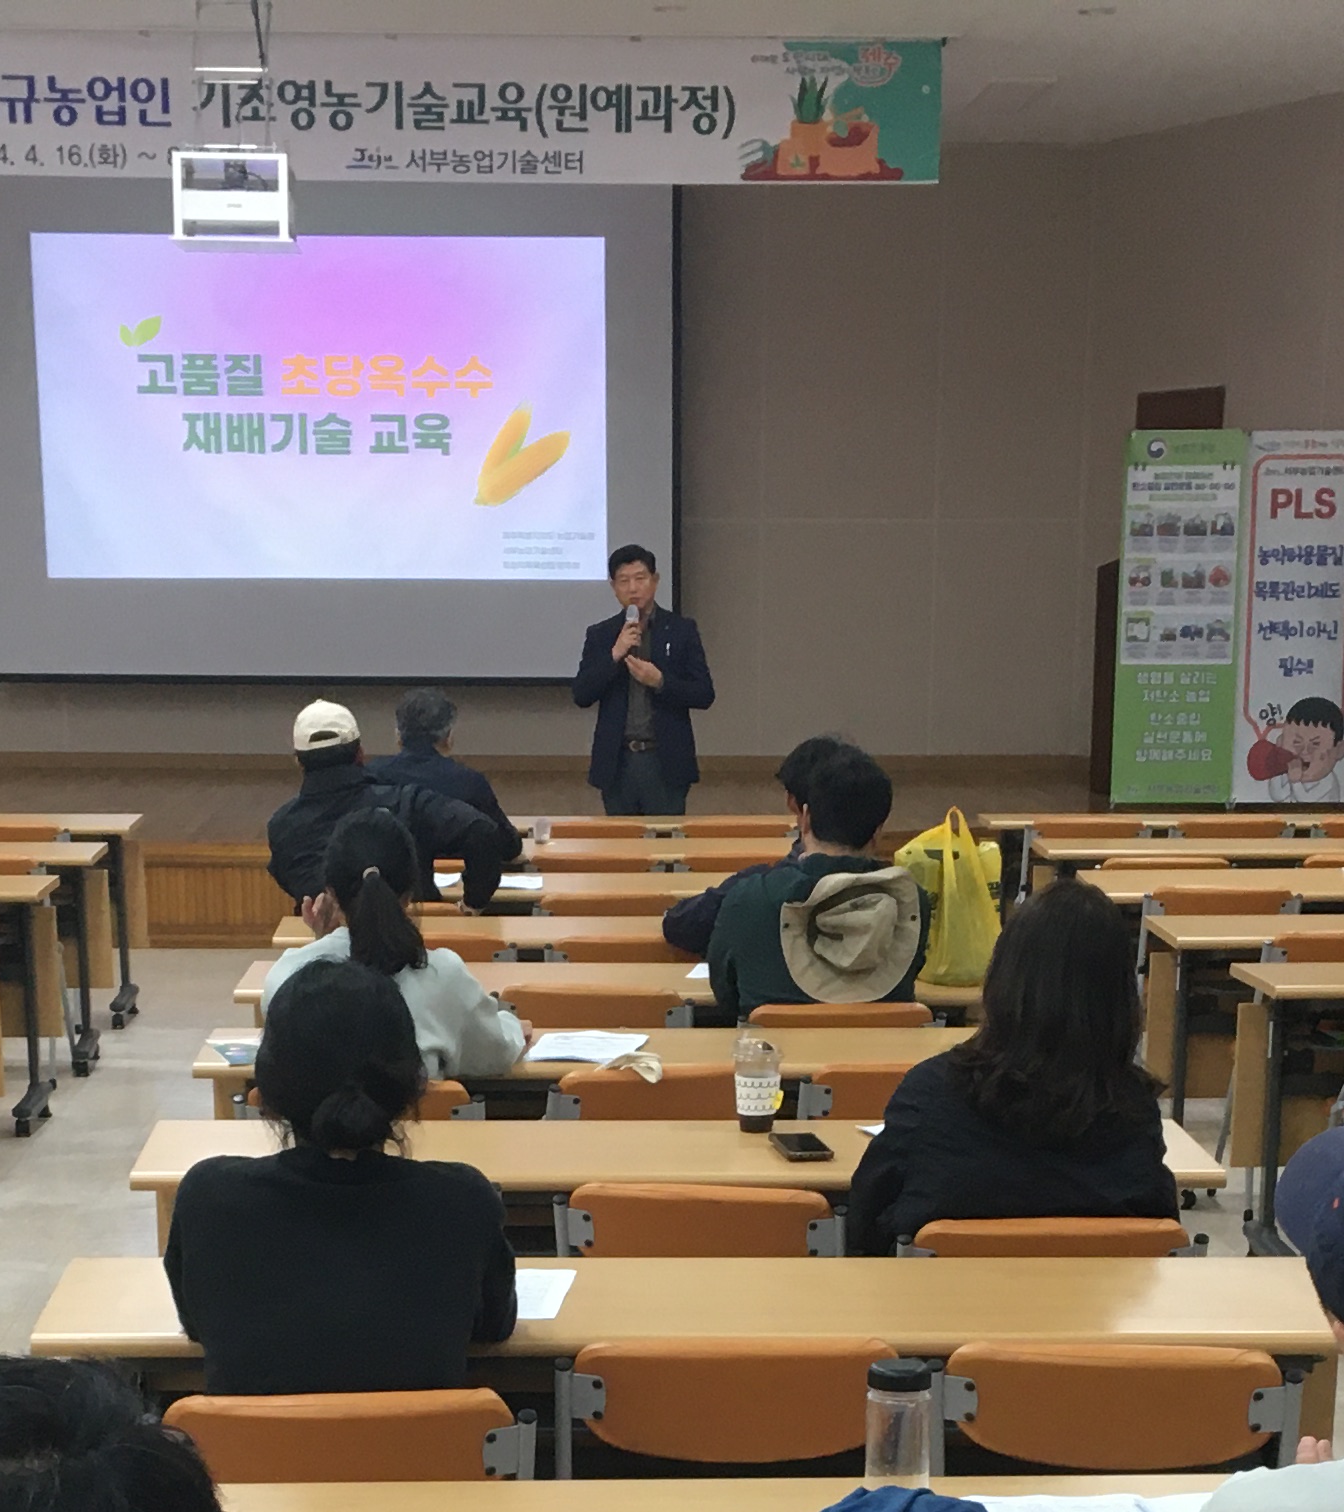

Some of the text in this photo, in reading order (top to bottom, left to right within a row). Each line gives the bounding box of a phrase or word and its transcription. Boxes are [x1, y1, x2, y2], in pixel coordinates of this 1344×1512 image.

[25, 144, 45, 167] 4.
[56, 144, 128, 170] 16.(화)
[406, 148, 584, 175] 서부농업기술센터
[137, 353, 493, 398] 고품질 초당옥수수
[182, 412, 452, 455] 재배기술 교육
[1270, 487, 1337, 519] PLS
